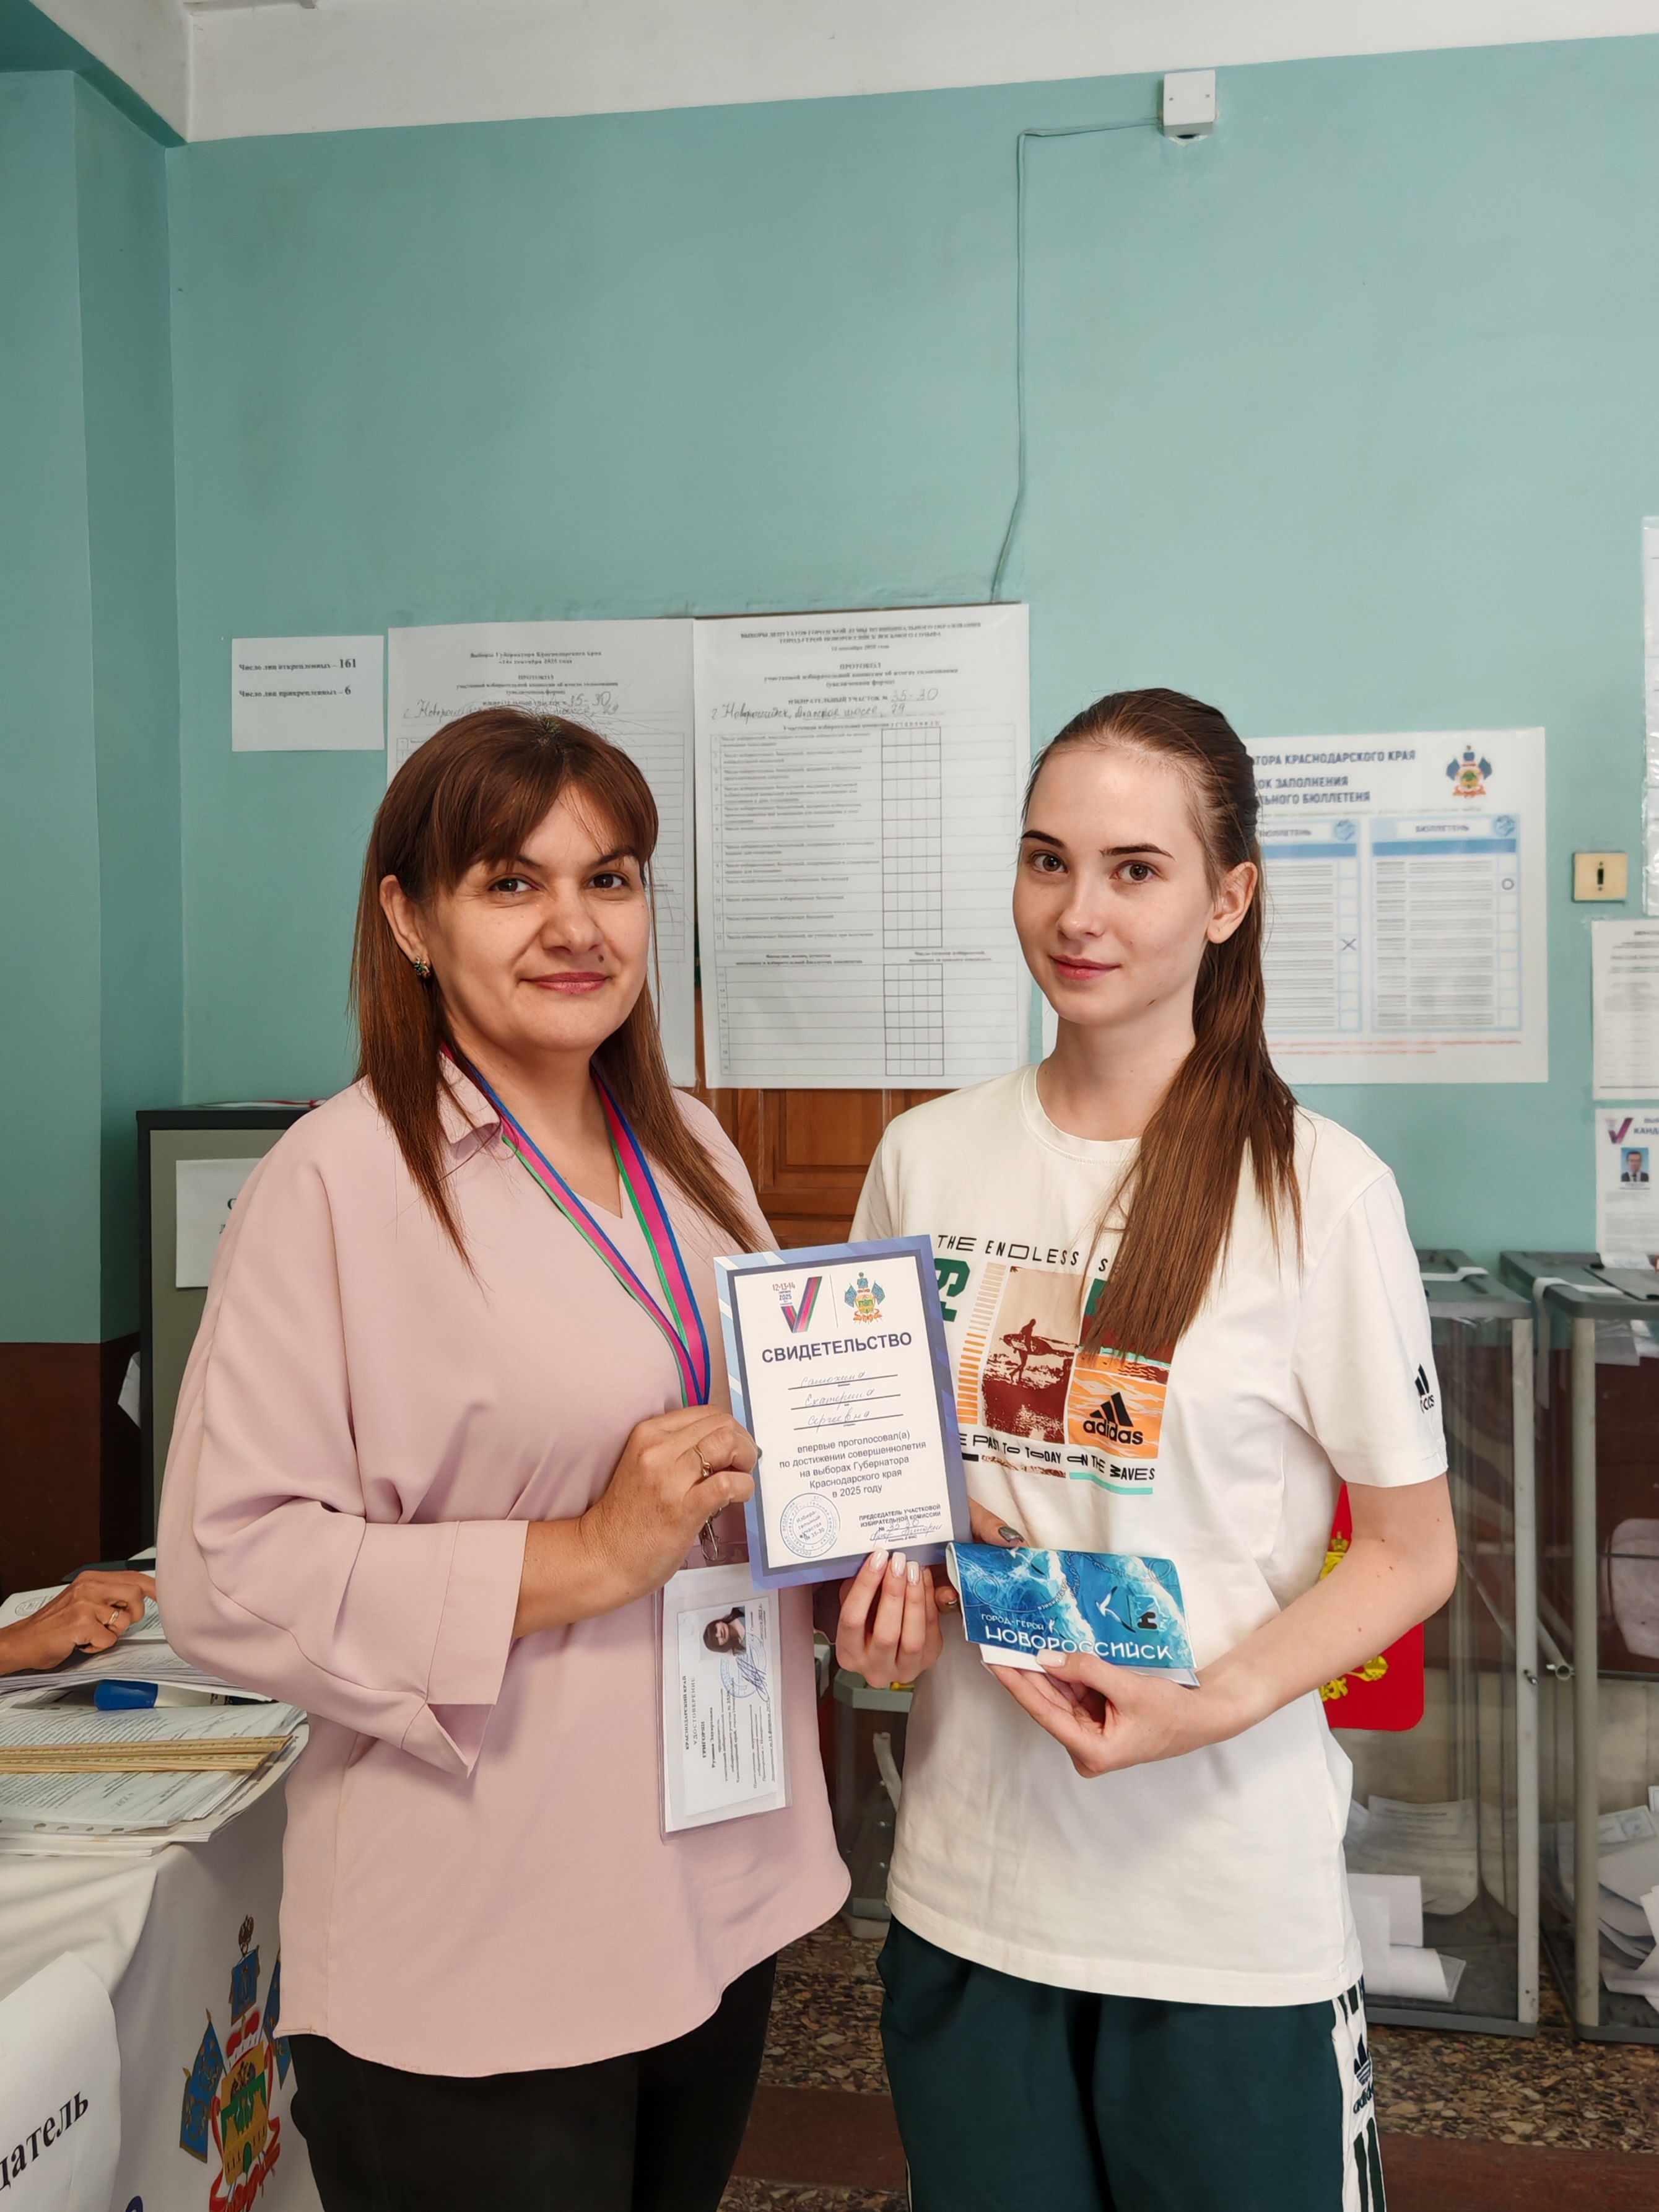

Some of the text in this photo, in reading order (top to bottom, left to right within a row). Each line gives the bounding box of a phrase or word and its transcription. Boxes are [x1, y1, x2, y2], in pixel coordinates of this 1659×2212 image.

[339, 658, 356, 668] 161
[345, 685, 351, 694] 6
[1284, 752, 1385, 764] КРАСНОДАРСКОГО
[1388, 750, 1416, 761] КРАЯ
[1256, 776, 1349, 790] ОК ЗАПОЛНЕНИЯ
[1302, 791, 1370, 803] БЮЛЛЕТЕНЯ
[938, 1235, 977, 1252] THE
[985, 1240, 1079, 1266] ENDLESS
[761, 1332, 912, 1363] СВИДЕТЕЛЬСТВО
[798, 1430, 910, 1453] впервые проголосовал(а)
[1083, 1419, 1143, 1445] adidas
[793, 1452, 845, 1467] достижении
[848, 1441, 926, 1459] совершеннолетия
[973, 1435, 999, 1451] PAST
[1003, 1443, 1021, 1454] TO
[1025, 1446, 1061, 1465] TODAY
[1091, 1455, 1106, 1474] THE
[813, 1465, 851, 1475] выборах
[853, 1456, 909, 1471] Губернатора
[810, 1469, 902, 1490] Краснодарского края
[840, 1487, 861, 1497] 2025
[864, 1484, 882, 1493] году
[860, 1503, 941, 1521] ПРЕДСЕДАТЕЛЬ УЧАСТКОВОЙ
[861, 1511, 941, 1528] ИЗБИРАТЕЛЬНОЙ КОМИССИИ
[985, 1625, 1173, 1660] НОВОРОССИЙСК
